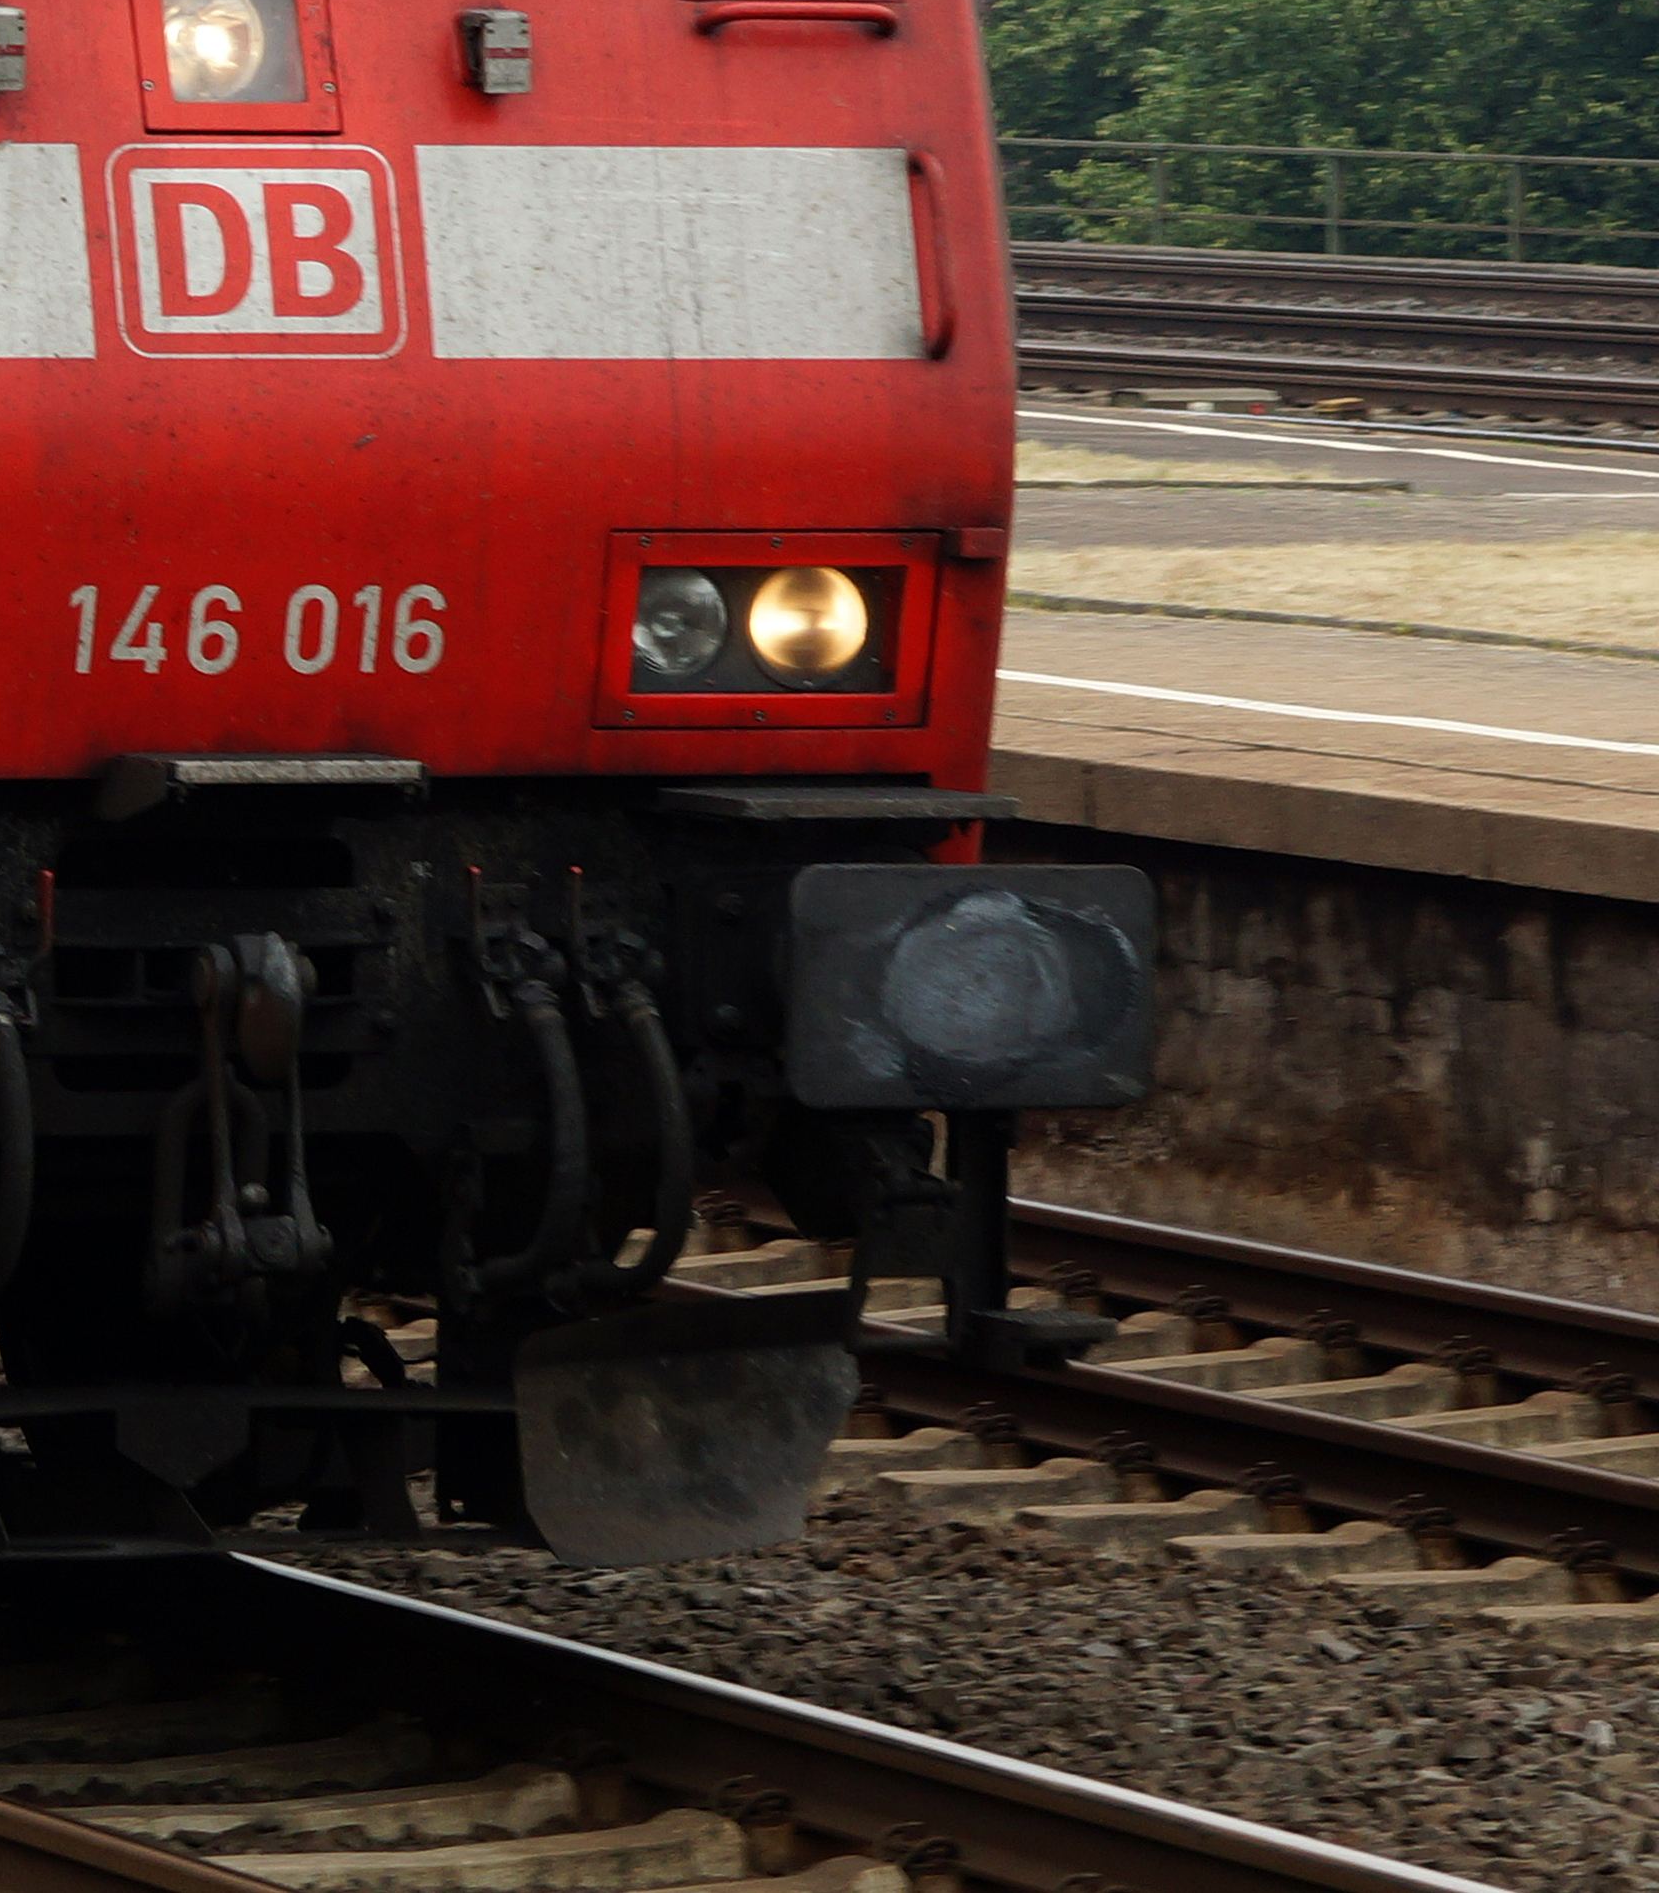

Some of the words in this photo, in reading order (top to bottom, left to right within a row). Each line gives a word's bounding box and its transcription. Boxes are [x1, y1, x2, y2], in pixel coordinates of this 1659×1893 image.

[150, 181, 365, 318] DB
[67, 584, 244, 675] 146
[283, 584, 448, 675] 016
